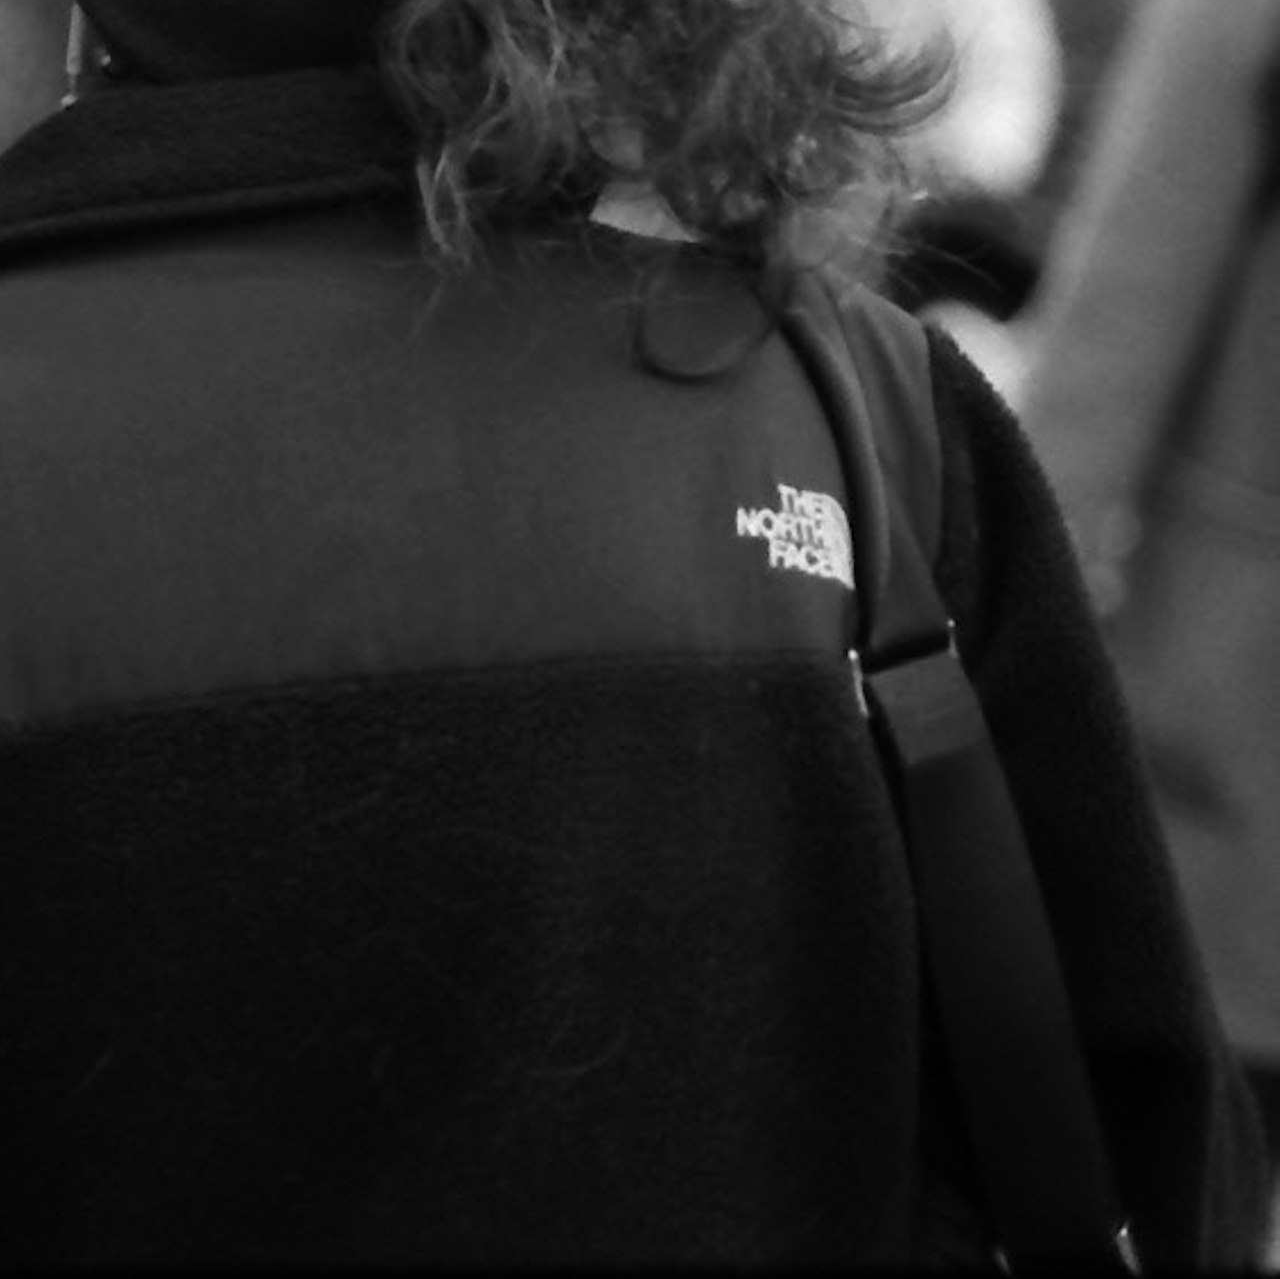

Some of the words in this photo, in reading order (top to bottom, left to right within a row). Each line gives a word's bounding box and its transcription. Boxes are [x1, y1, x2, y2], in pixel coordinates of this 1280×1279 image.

[777, 483, 824, 519] THE
[736, 507, 826, 548] NORTH
[769, 540, 835, 578] FACE
